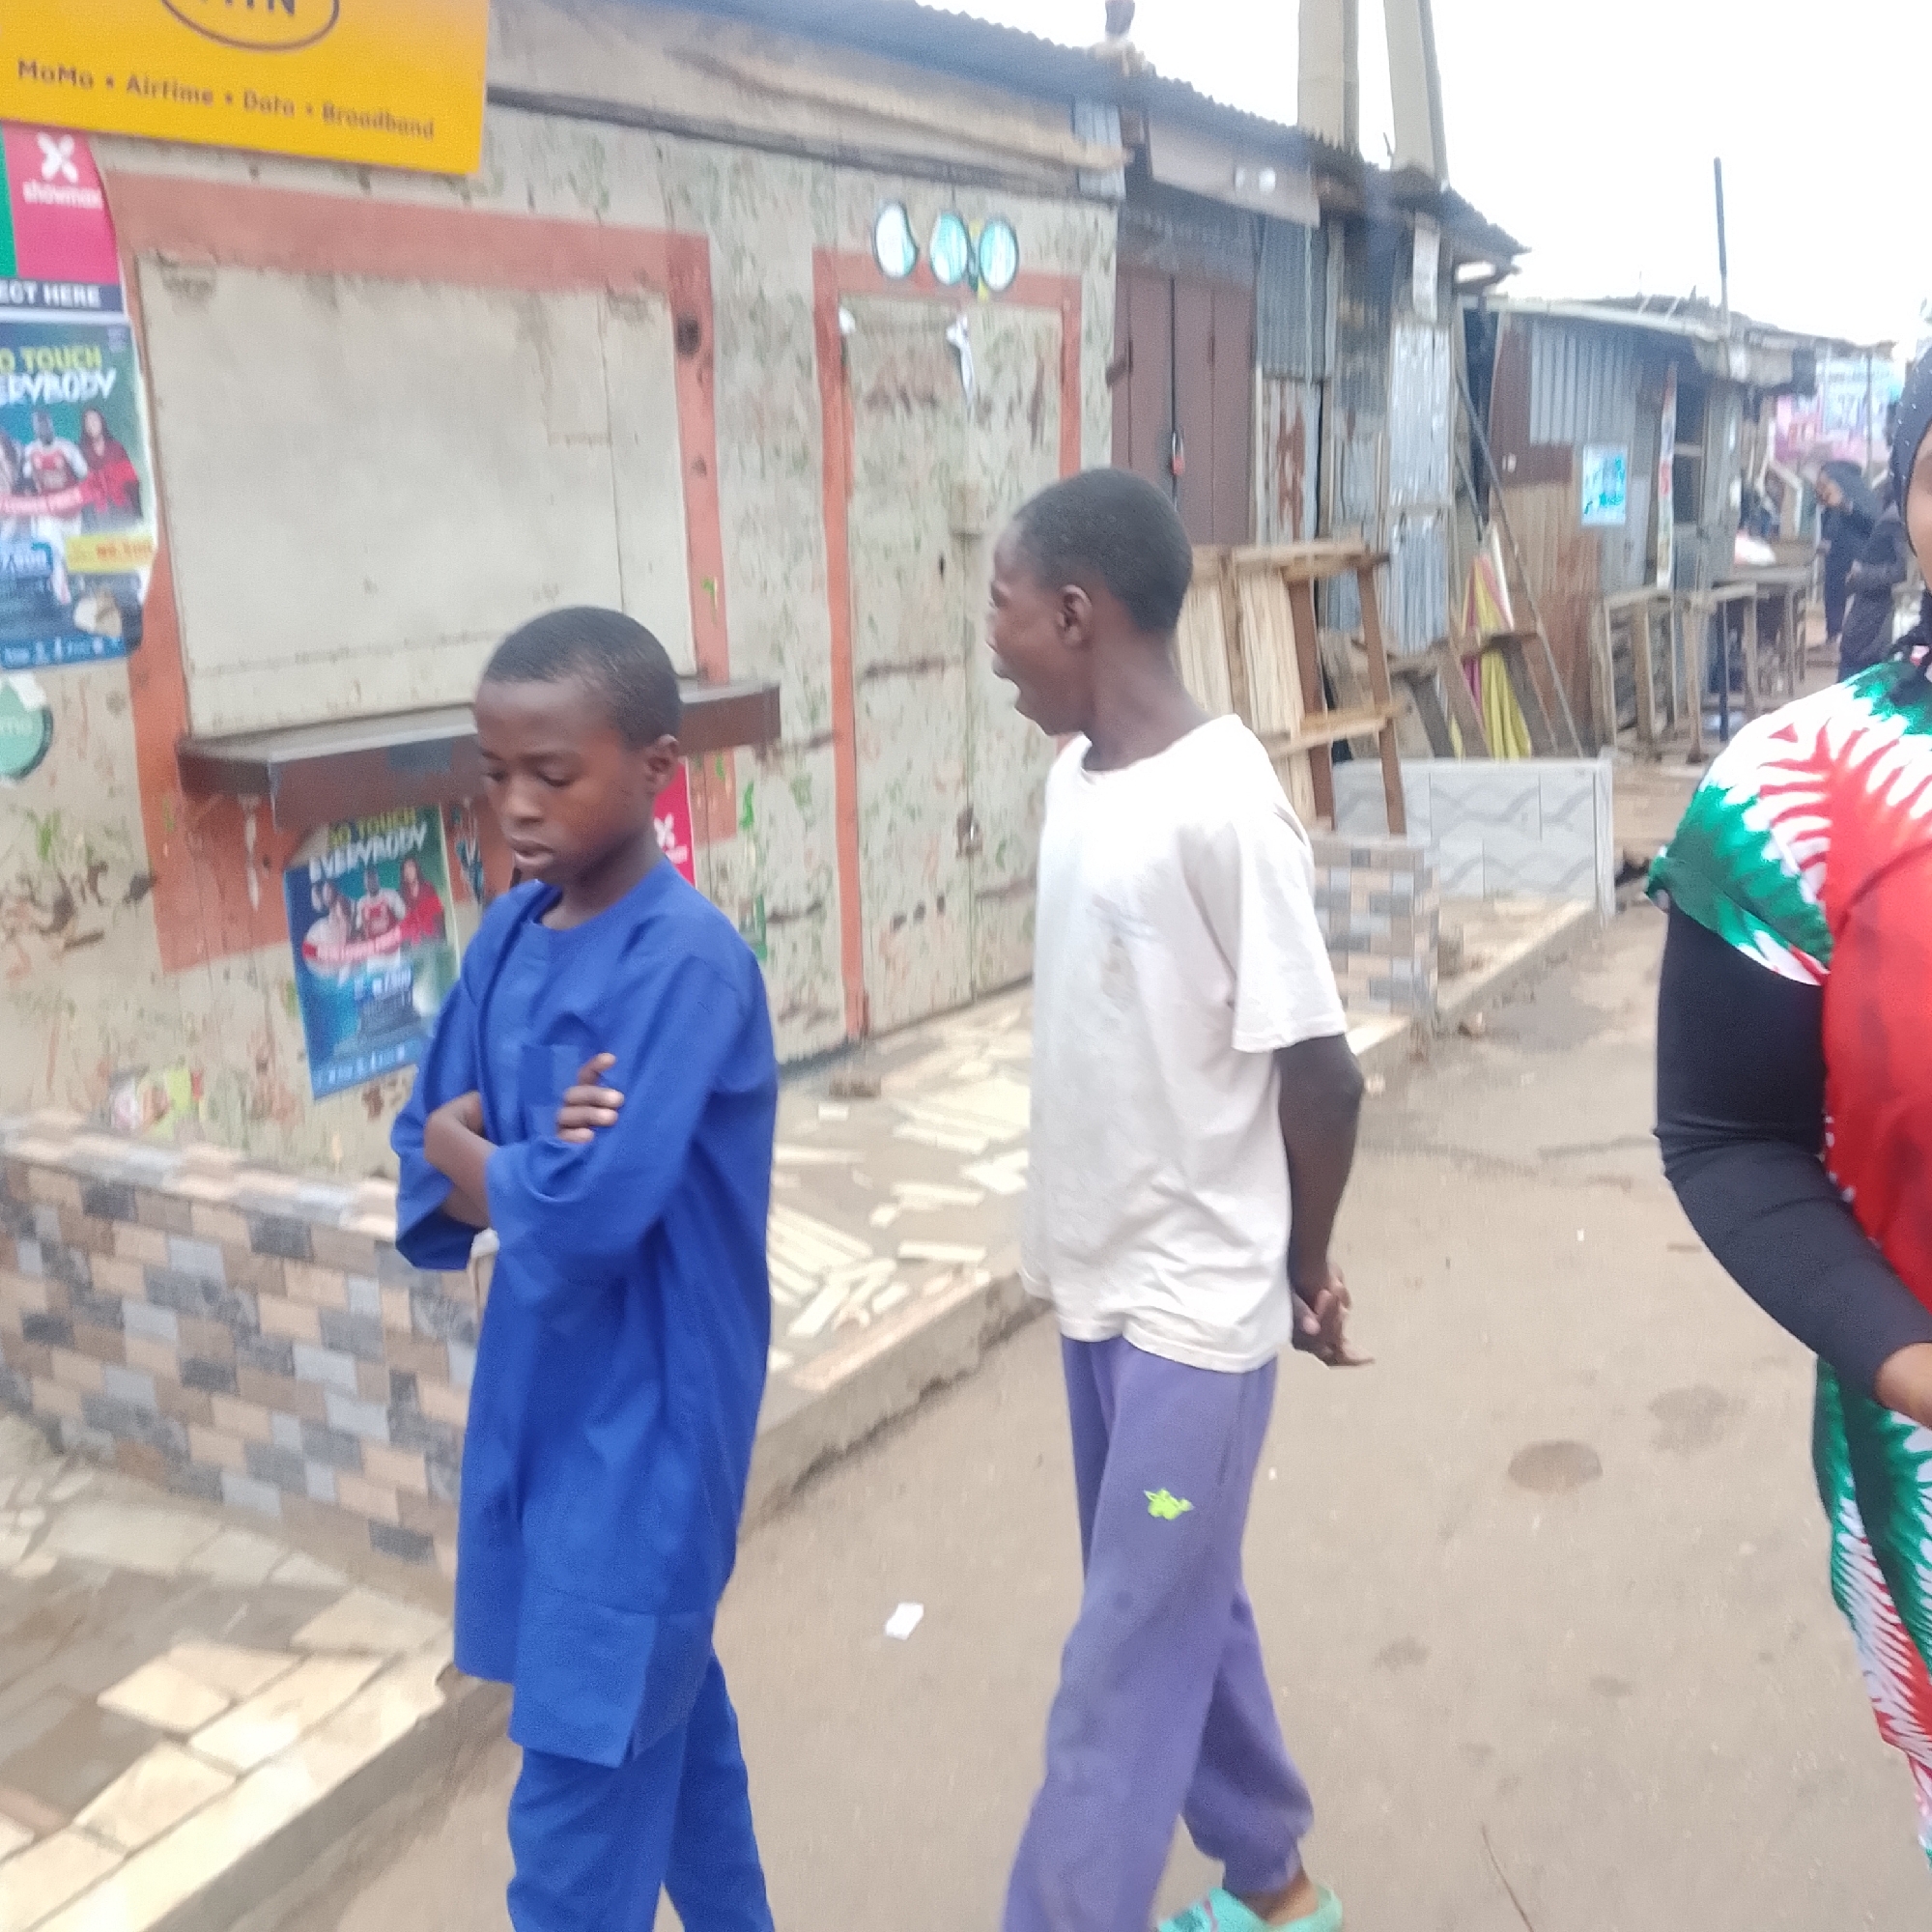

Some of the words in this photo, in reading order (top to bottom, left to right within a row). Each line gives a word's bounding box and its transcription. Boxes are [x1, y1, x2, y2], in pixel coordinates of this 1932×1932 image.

[18, 57, 95, 91] MoMo
[126, 72, 214, 107] Airtime
[242, 88, 296, 118] Data
[321, 99, 435, 142] Broadband
[43, 281, 101, 308] HERE
[19, 344, 102, 375] TOUCH
[308, 820, 428, 884] EVERYBODY
